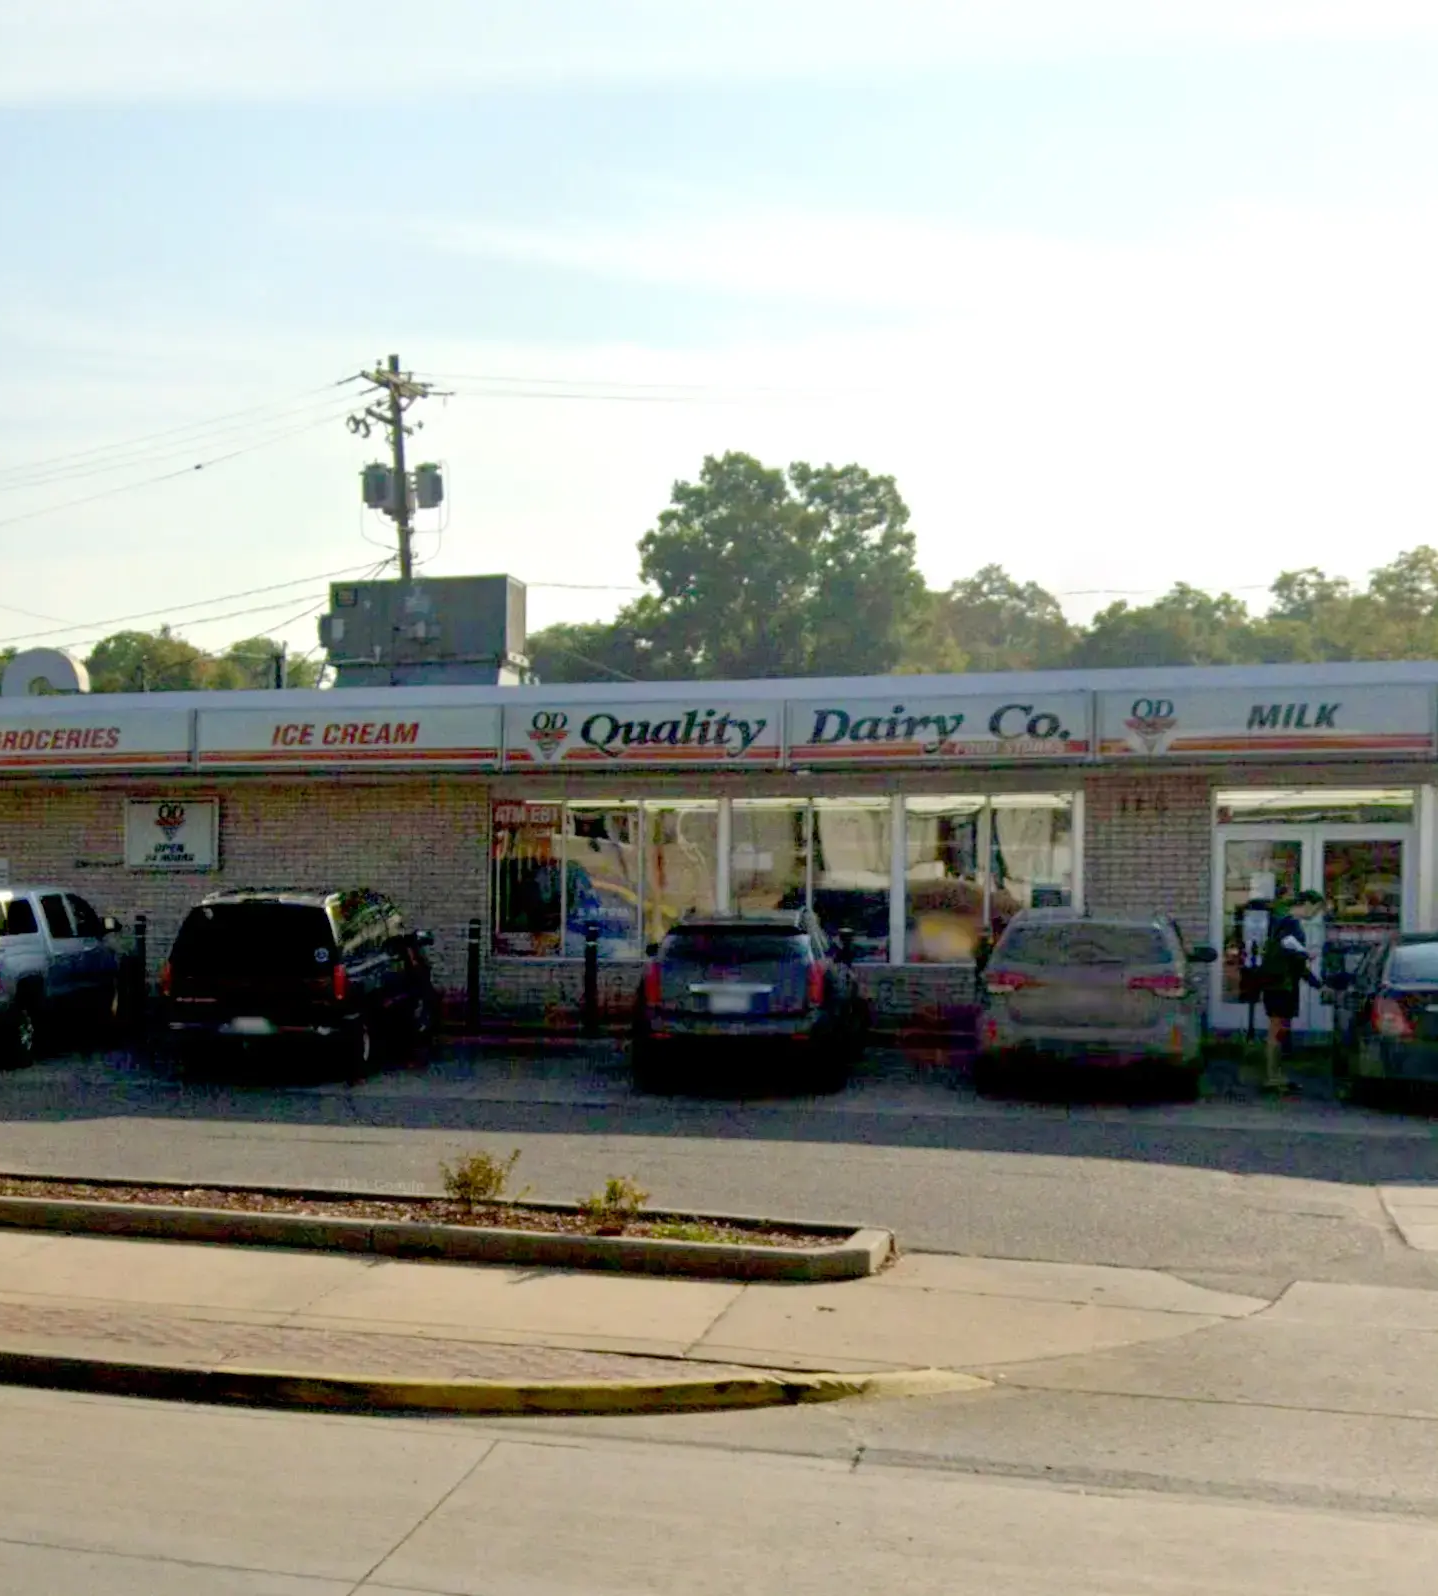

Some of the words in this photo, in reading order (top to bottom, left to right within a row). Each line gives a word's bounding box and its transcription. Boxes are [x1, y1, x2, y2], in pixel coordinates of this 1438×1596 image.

[532, 711, 568, 736] QD
[1131, 698, 1175, 727] QD
[1246, 702, 1342, 731] MILK
[271, 723, 316, 746] ICE
[322, 721, 420, 745] CREAM
[580, 707, 767, 758] Quality
[805, 704, 964, 754] Dairy
[988, 703, 1072, 741] Co.
